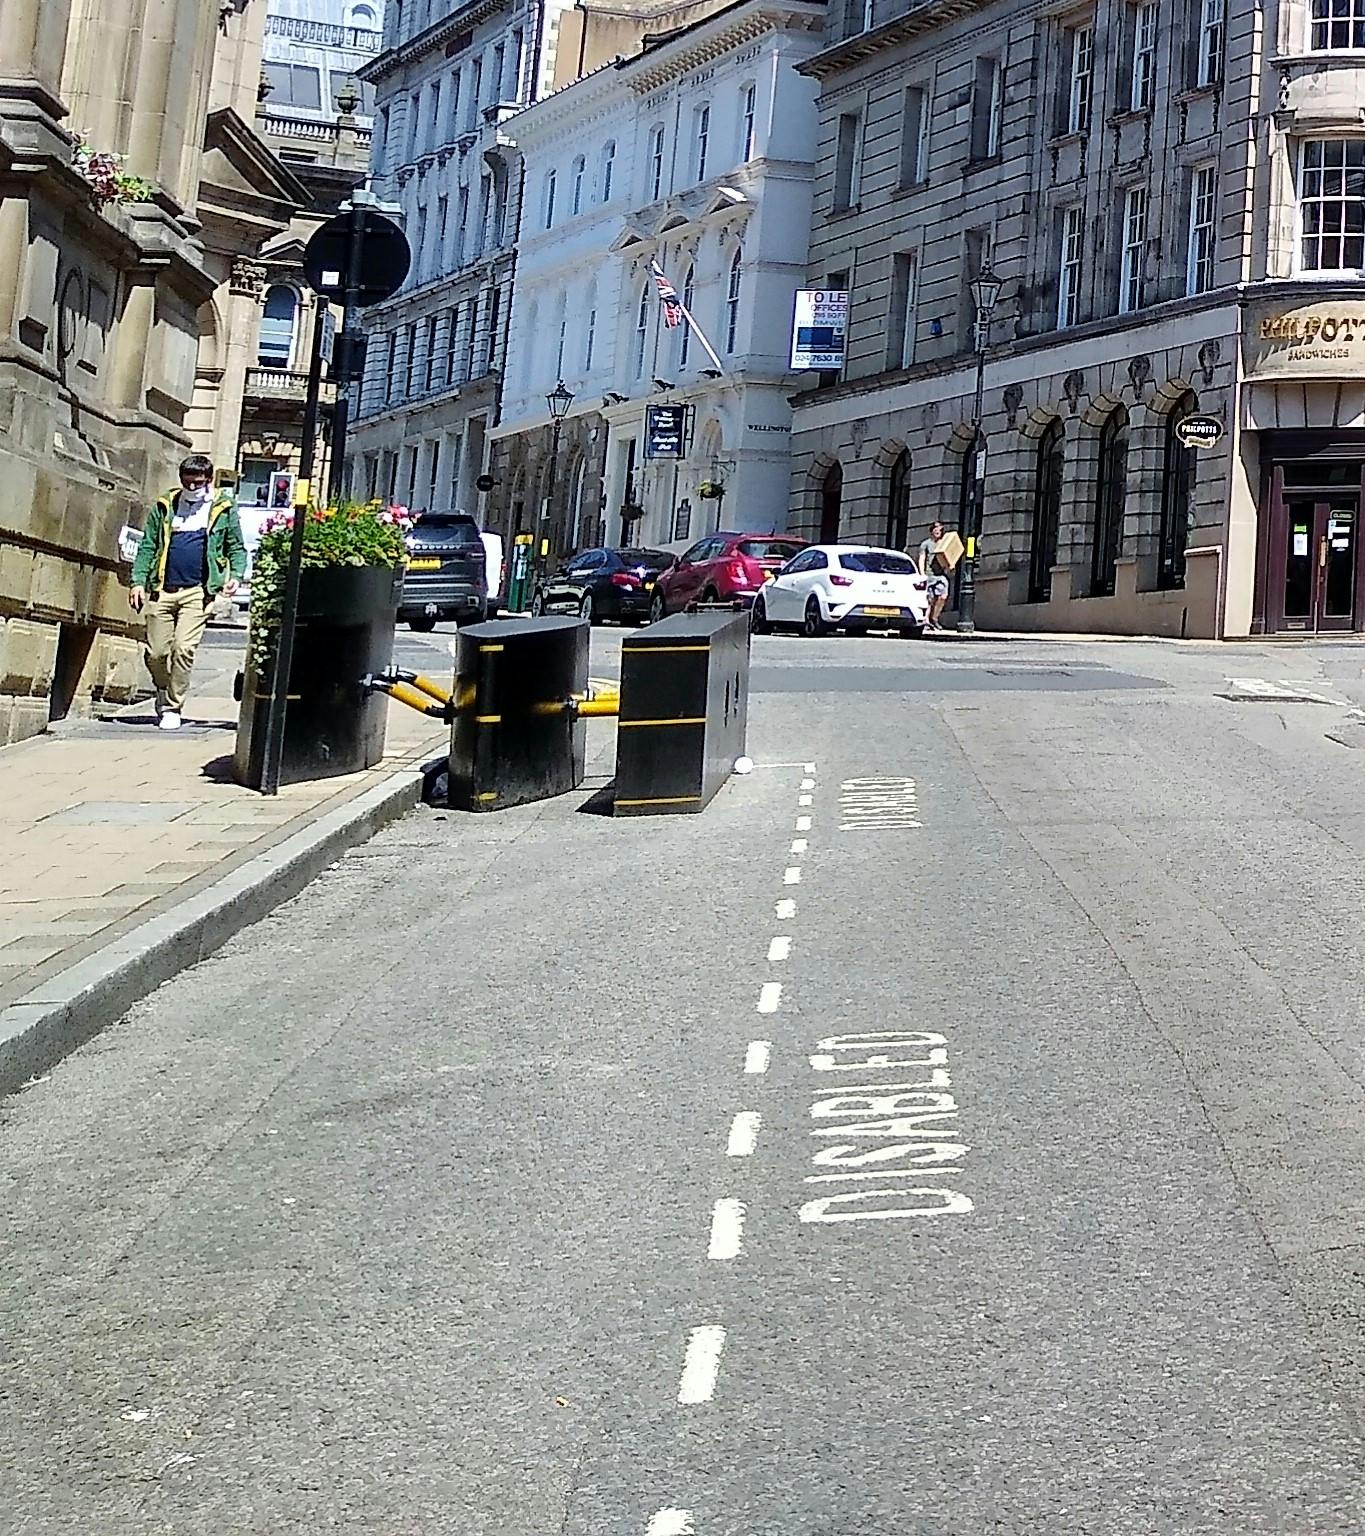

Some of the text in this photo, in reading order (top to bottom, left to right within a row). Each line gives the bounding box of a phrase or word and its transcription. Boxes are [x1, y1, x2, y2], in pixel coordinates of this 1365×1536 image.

[805, 291, 848, 303] TO LE
[811, 304, 848, 312] OFFICES
[1287, 348, 1350, 362] SANDWICHES
[1181, 425, 1218, 434] PHILPOTTS
[798, 1031, 975, 1224] DISABLED
